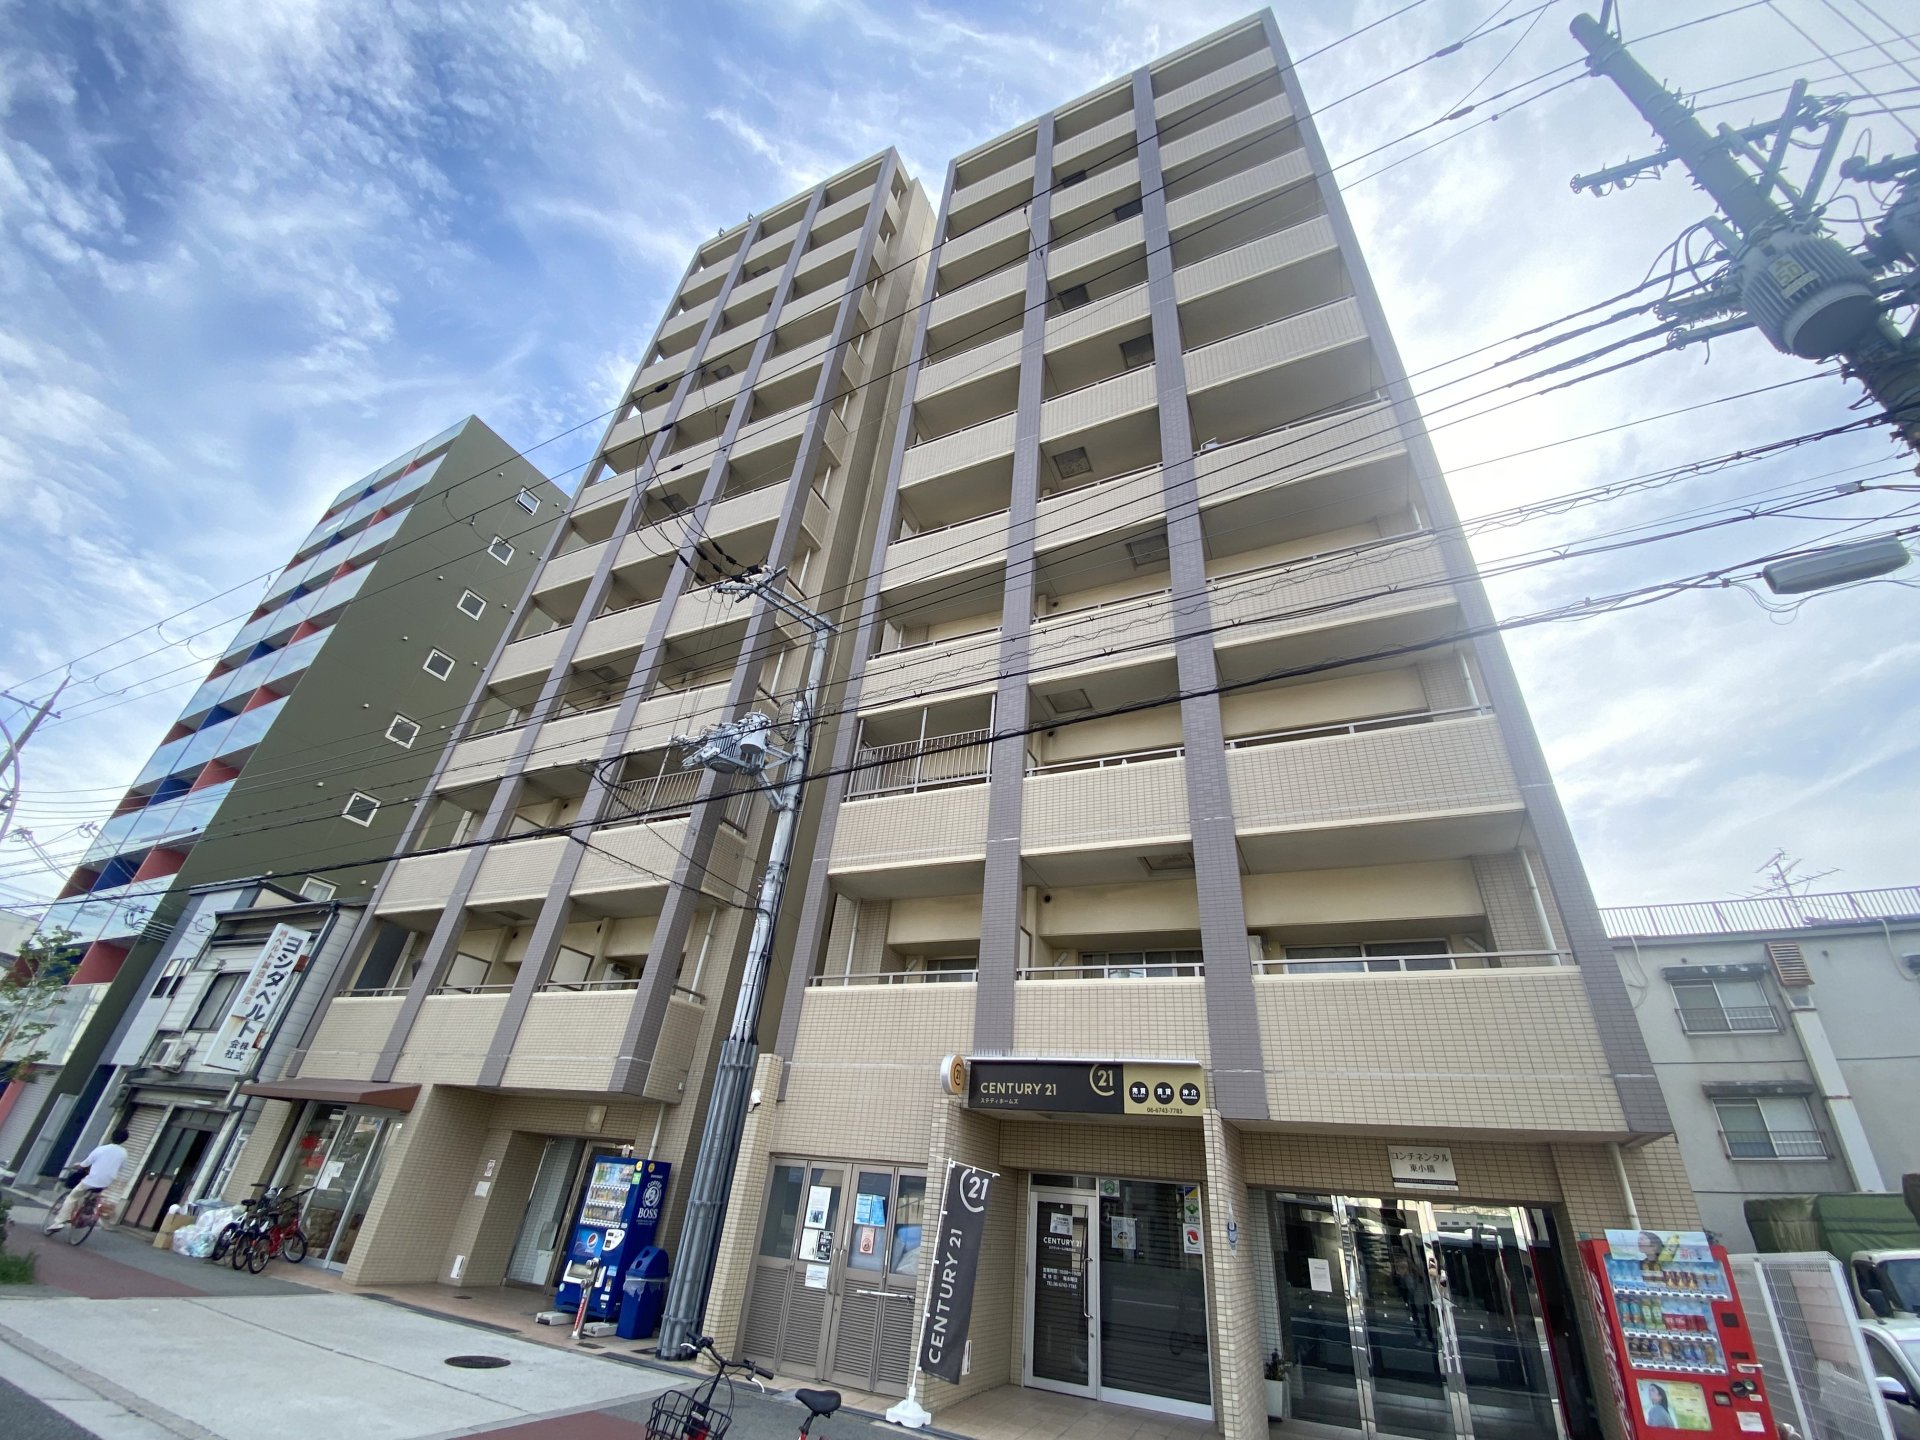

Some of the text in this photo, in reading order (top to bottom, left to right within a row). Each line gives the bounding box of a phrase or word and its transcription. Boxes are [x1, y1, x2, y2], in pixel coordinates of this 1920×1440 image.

[238, 936, 303, 1038] ヨシダベルト
[980, 1082, 1057, 1096] CENTURY 21
[1391, 1152, 1449, 1162] コンチネンタル
[1409, 1163, 1436, 1173] 東小橋
[637, 1207, 658, 1219] BOSS
[1043, 1236, 1074, 1247] CENTURY
[928, 1228, 963, 1364] CENTURY 21
